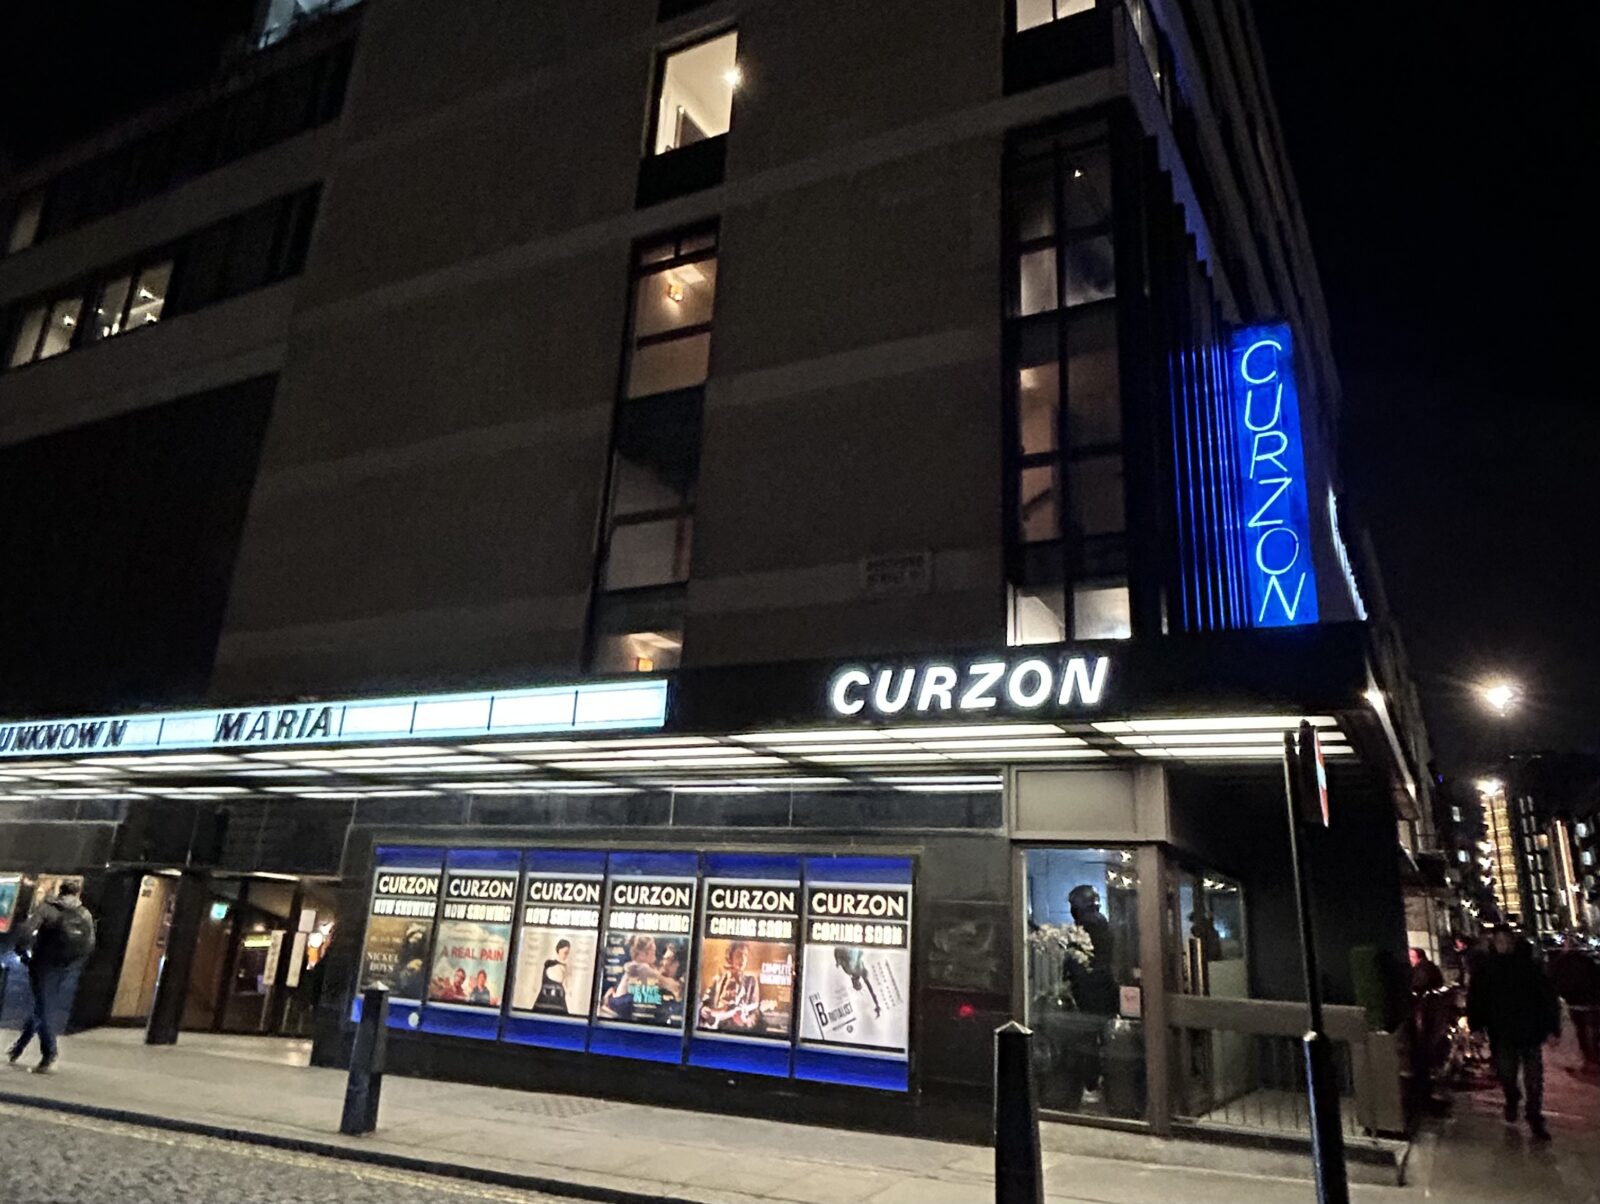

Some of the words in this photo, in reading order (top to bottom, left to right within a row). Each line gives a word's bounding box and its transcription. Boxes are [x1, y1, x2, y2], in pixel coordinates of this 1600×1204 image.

[1241, 340, 1306, 622] CURZON
[832, 656, 1109, 715] CURZON
[214, 706, 333, 743] MARIA
[0, 719, 129, 752] UNKNOWN
[378, 875, 439, 895] CURZON
[450, 879, 514, 898] CURZON
[530, 882, 600, 902] CURZON
[614, 885, 690, 906] CURZON
[374, 899, 394, 915] NOW
[394, 900, 436, 917] SHOWING
[711, 889, 795, 912] CURZON
[812, 892, 904, 917] CURZON
[444, 903, 467, 920] NOW
[467, 904, 512, 922] SHOWING
[525, 907, 549, 924] NOW
[549, 909, 599, 927] SHOWING
[610, 911, 635, 929] NOW
[636, 913, 690, 932] SHOWING
[710, 916, 757, 937] COMING
[757, 919, 793, 939] SOON
[812, 922, 863, 943] COMING
[864, 924, 902, 945] SOON
[451, 947, 476, 959] REAL
[480, 948, 505, 961] PAIN
